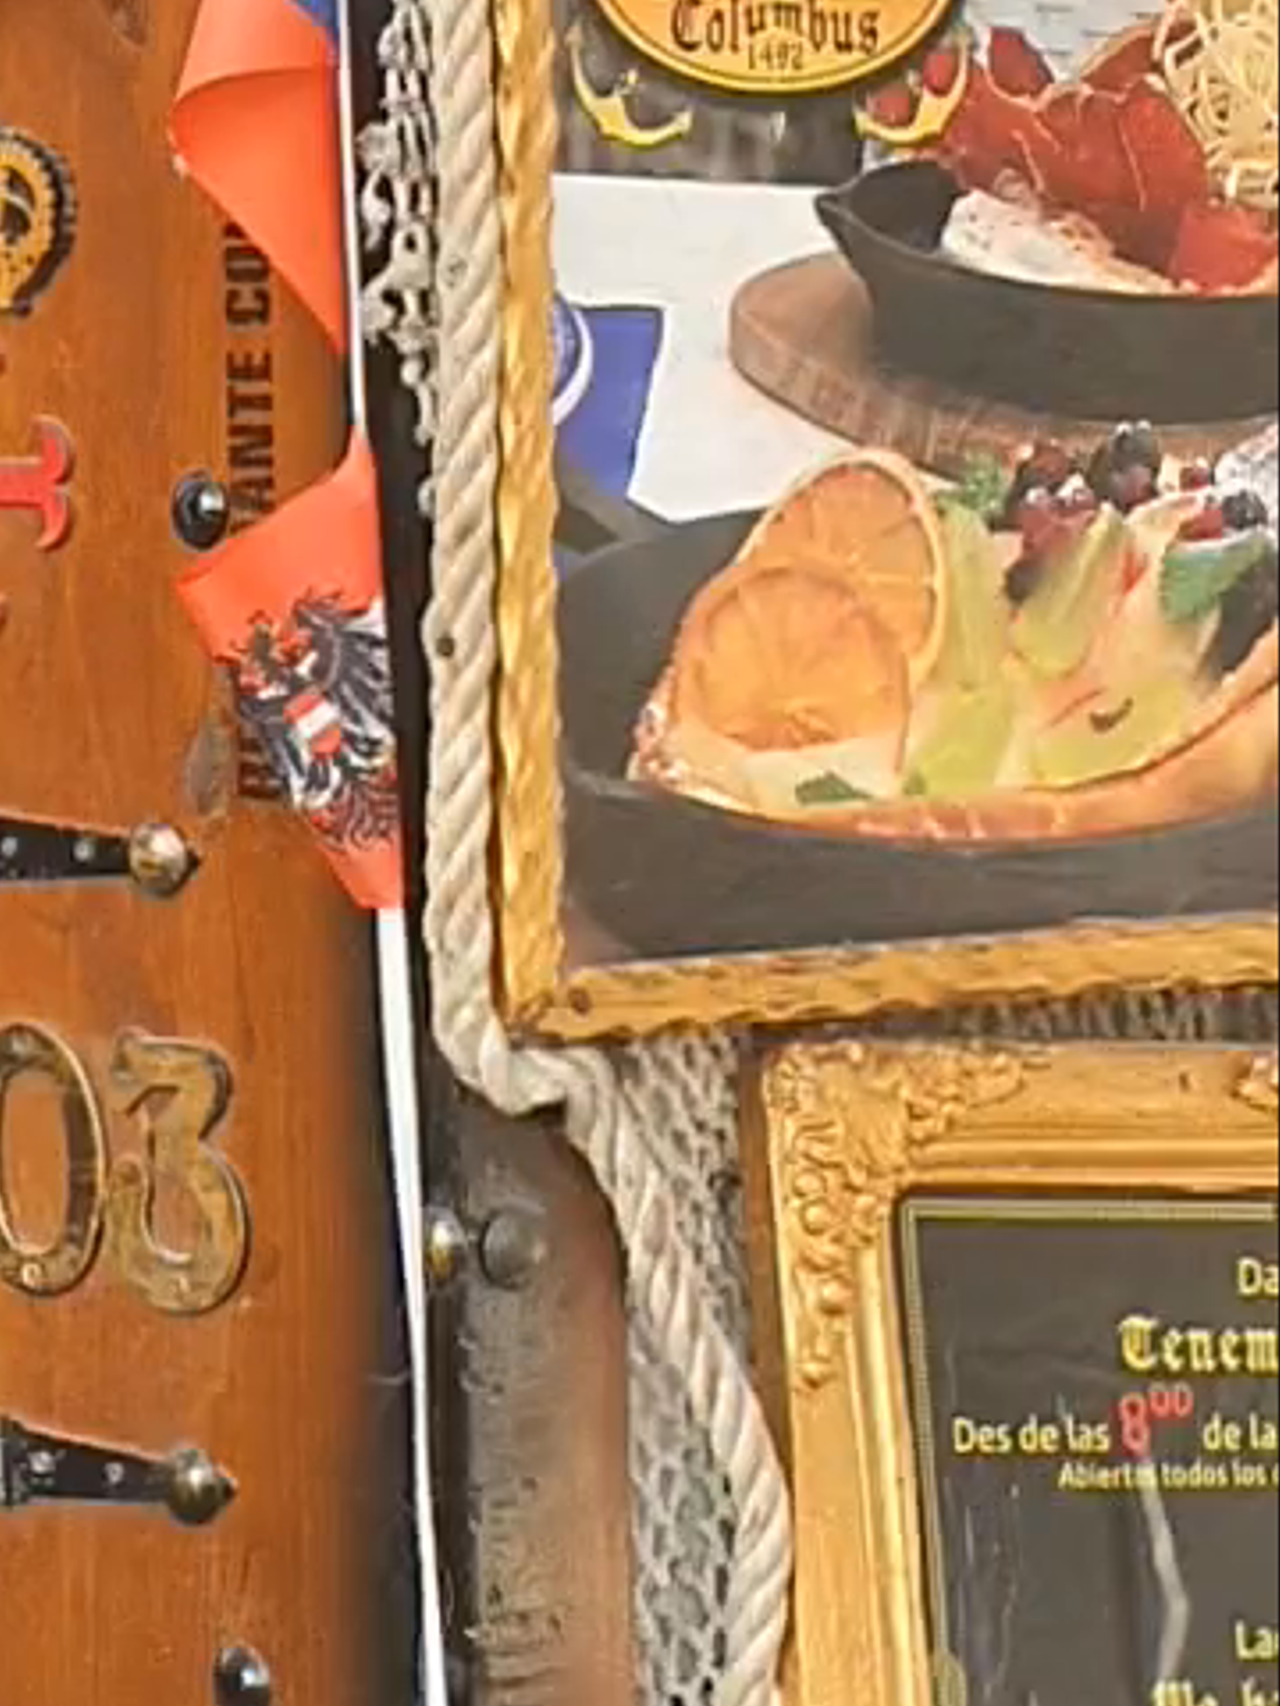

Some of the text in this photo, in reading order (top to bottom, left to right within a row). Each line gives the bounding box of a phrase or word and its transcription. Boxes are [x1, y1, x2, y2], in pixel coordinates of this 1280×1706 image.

[746, 40, 805, 72] 1492
[951, 1416, 1012, 1454] Des
[1018, 1414, 1059, 1453] de
[1064, 1414, 1111, 1453] las
[1203, 1412, 1240, 1451] de
[1162, 1462, 1228, 1487] todos
[1232, 1459, 1266, 1486] los
